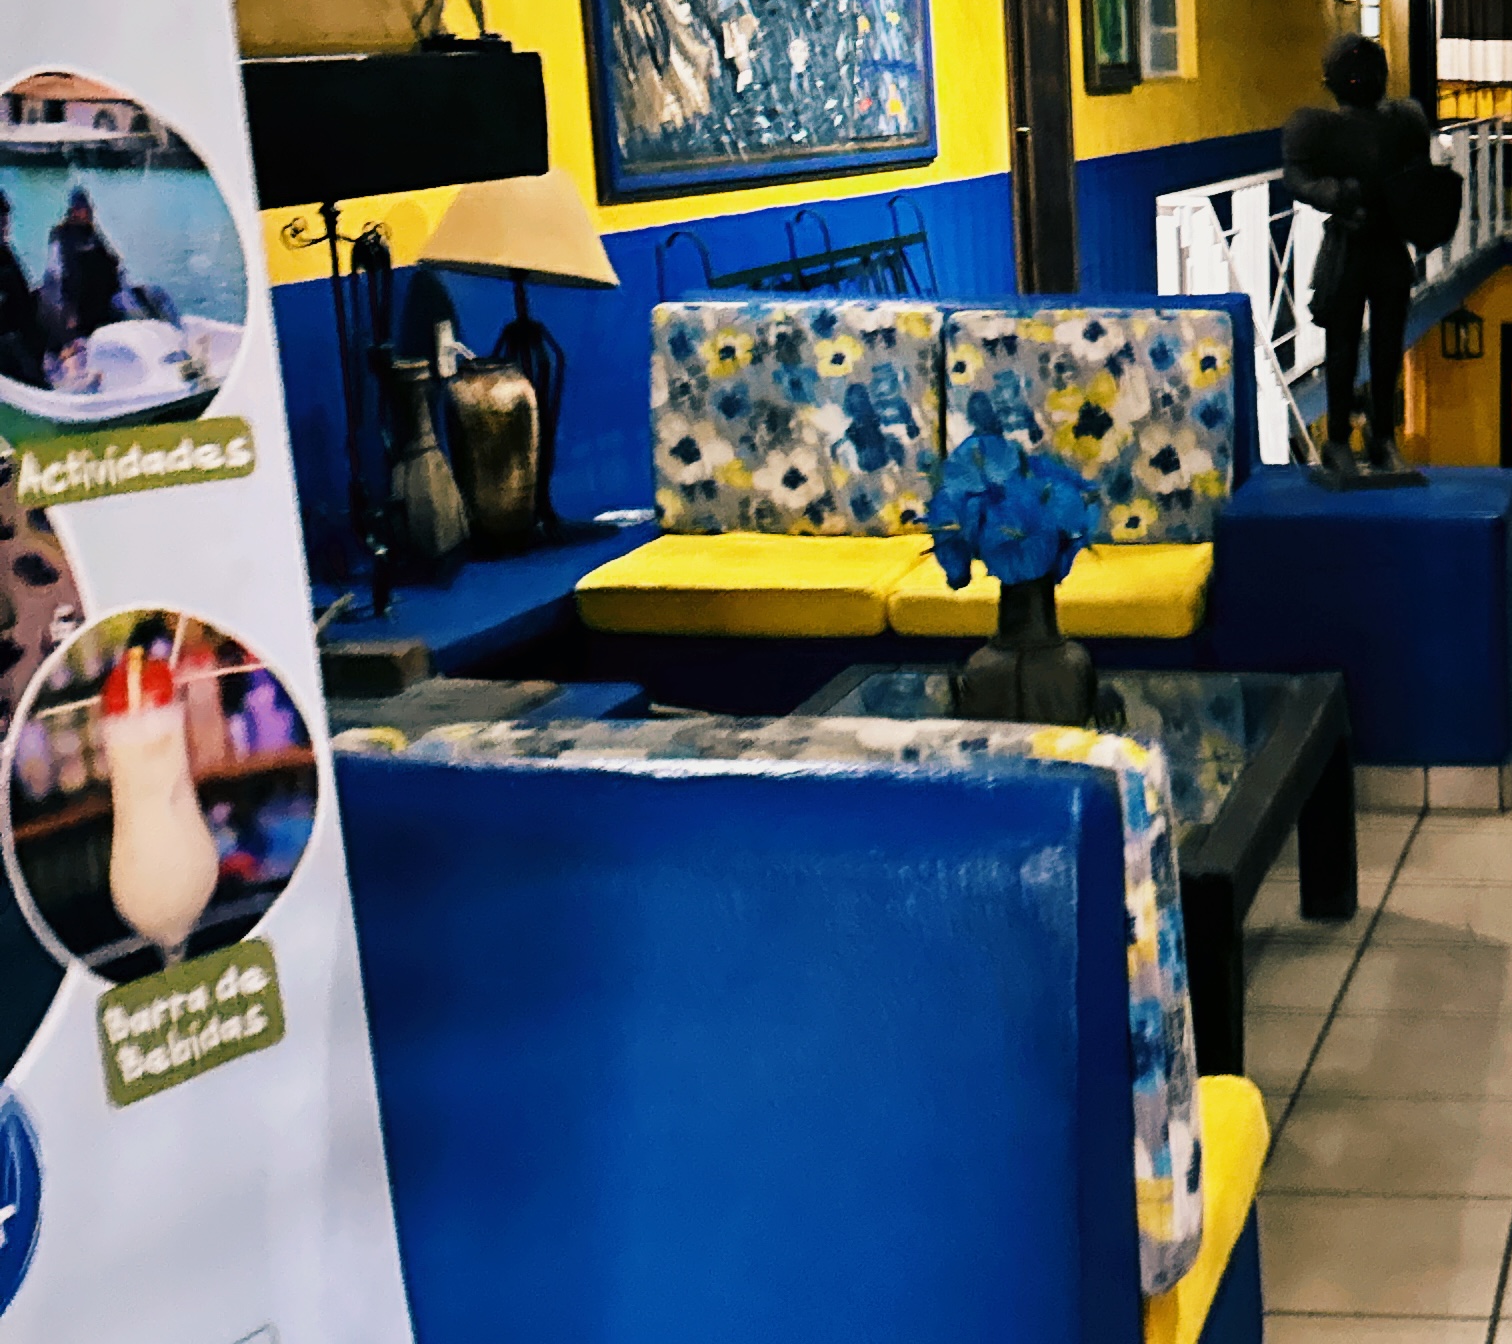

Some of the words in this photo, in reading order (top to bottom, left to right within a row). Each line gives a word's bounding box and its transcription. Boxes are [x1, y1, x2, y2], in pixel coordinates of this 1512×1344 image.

[17, 436, 250, 502] Actividades
[103, 984, 211, 1044] Barra
[215, 964, 271, 1002] de
[115, 1004, 269, 1085] Bebidas
